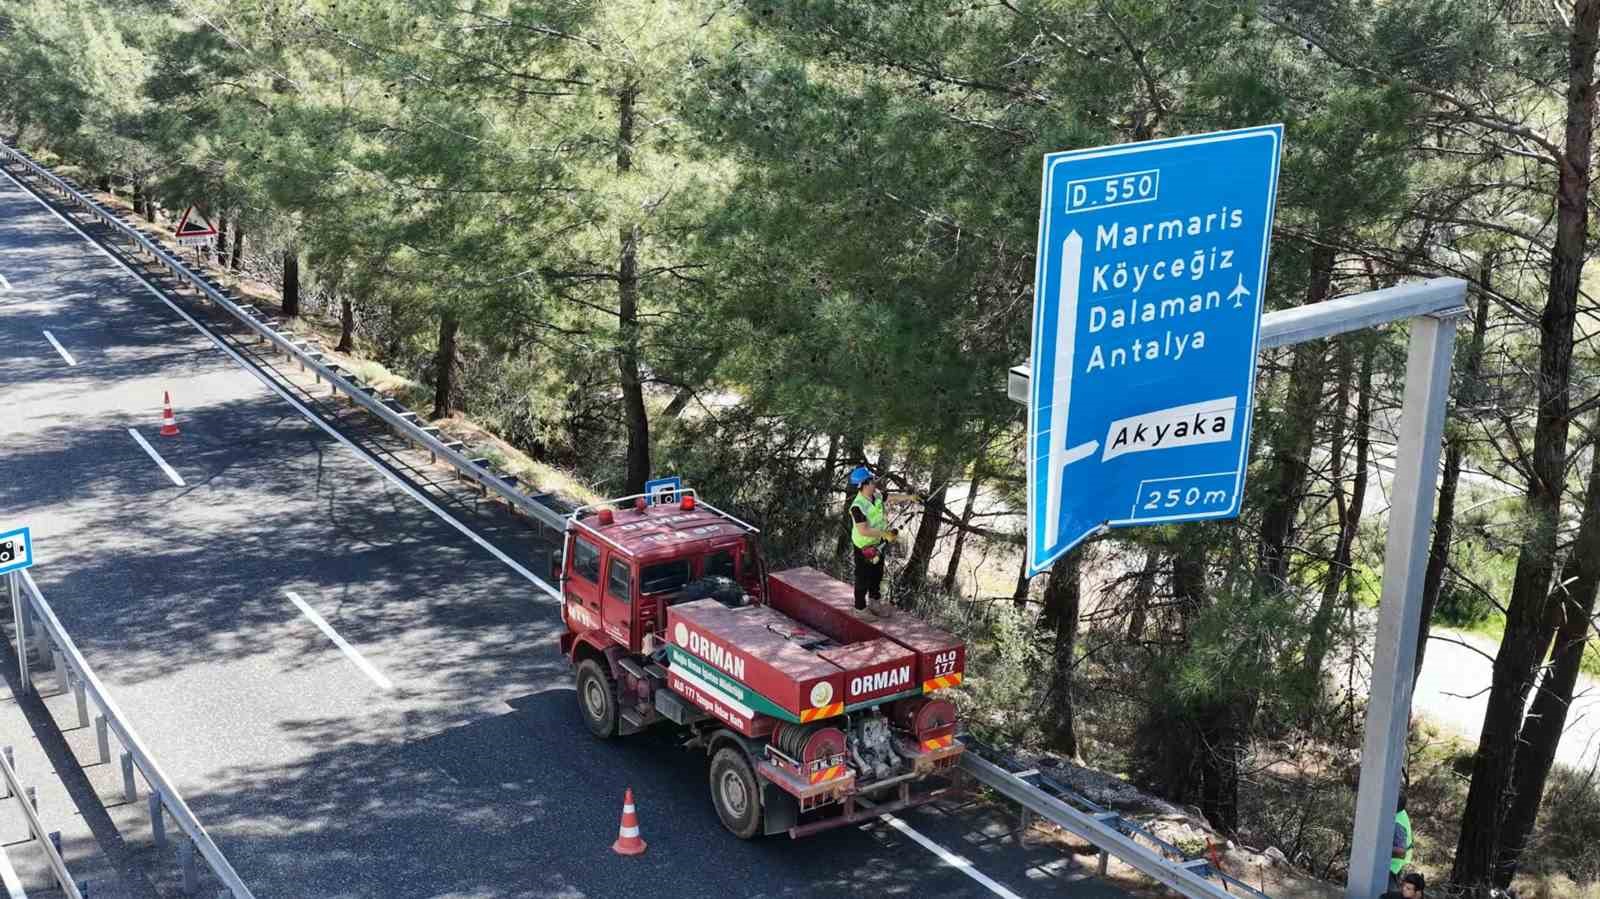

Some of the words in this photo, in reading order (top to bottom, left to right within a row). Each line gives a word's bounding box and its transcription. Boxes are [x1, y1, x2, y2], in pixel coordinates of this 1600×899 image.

[1096, 207, 1243, 252] Marmaris
[1092, 247, 1234, 293] Köyceğiz
[1089, 290, 1220, 333] Dalaman
[1086, 330, 1206, 373] Antalya
[1111, 413, 1226, 450] Akyaka
[690, 631, 744, 681] ORMAN
[935, 650, 956, 664] ALO
[935, 661, 955, 675] 177
[851, 665, 910, 696] ORMAN
